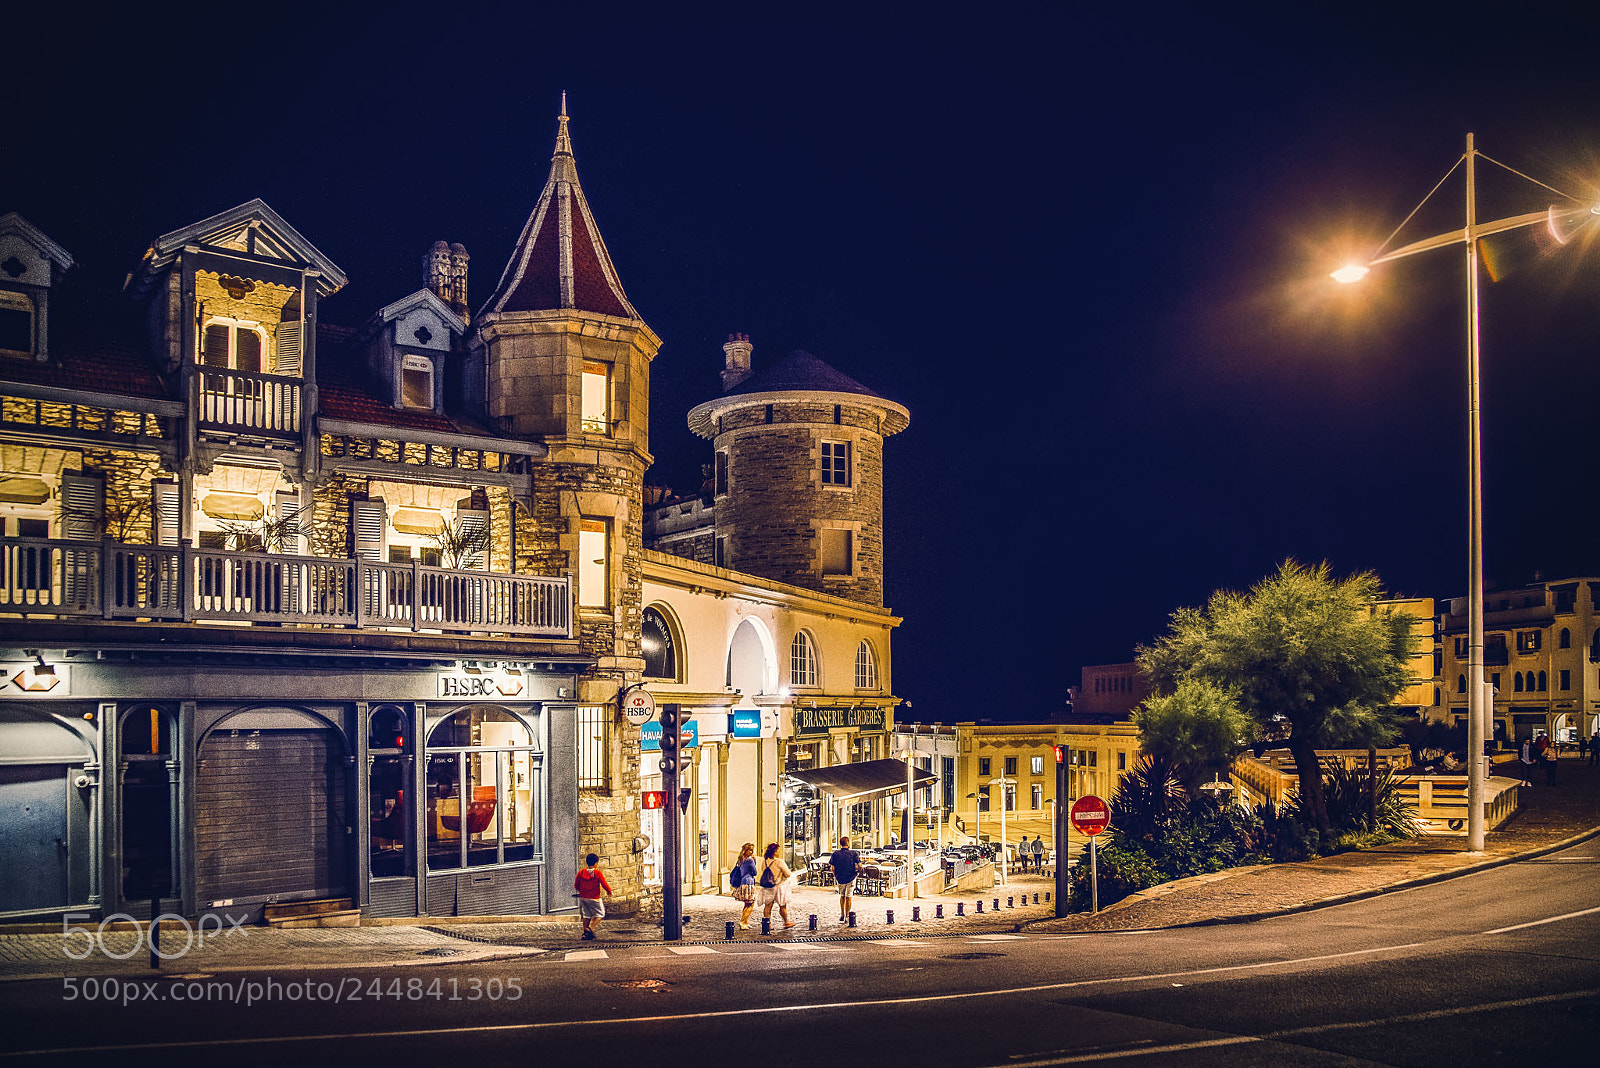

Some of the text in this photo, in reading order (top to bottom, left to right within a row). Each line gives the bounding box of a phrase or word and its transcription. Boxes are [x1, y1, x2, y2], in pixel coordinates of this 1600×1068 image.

[442, 677, 494, 697] HSBC
[627, 706, 651, 717] HSBC
[802, 709, 882, 728] BRASSERIE GARDERES
[641, 730, 664, 741] HAVA
